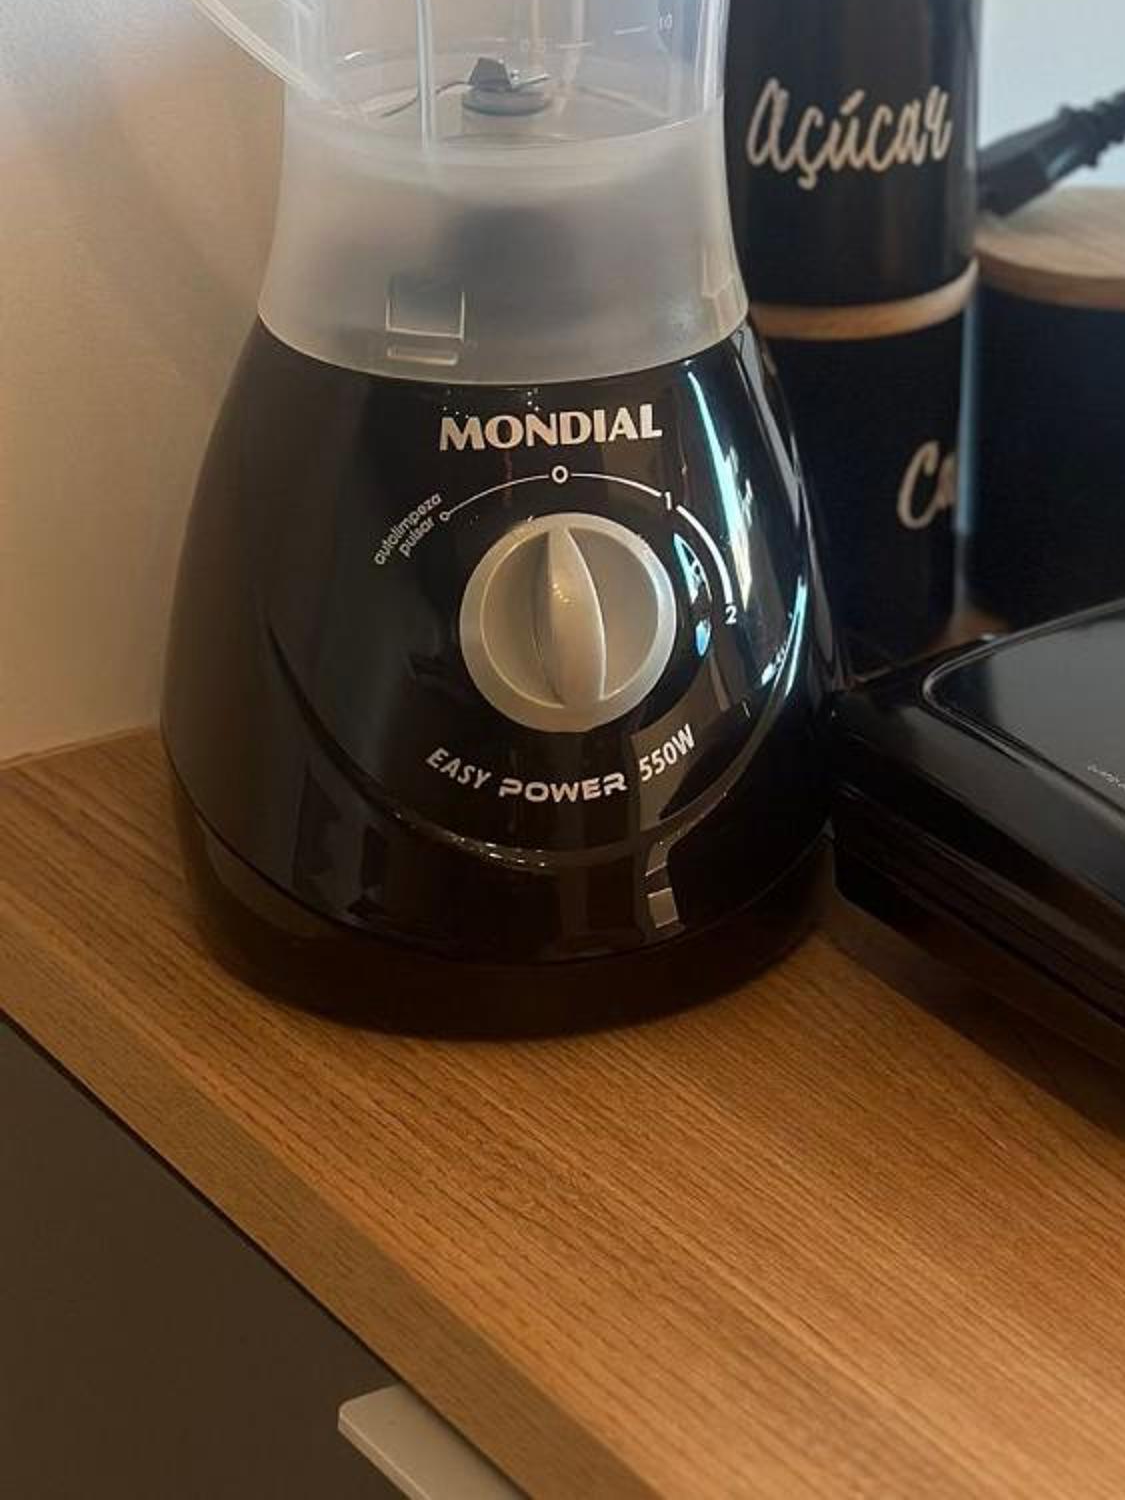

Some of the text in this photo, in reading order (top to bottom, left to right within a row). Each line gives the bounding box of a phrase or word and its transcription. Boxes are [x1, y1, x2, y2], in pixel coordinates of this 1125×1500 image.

[746, 77, 954, 190] Açúcar
[439, 403, 663, 452] MONDIAL
[663, 491, 673, 510] 1
[399, 517, 434, 558] pulsar
[724, 604, 738, 625] 2
[425, 723, 696, 803] EASY POWER 550W
